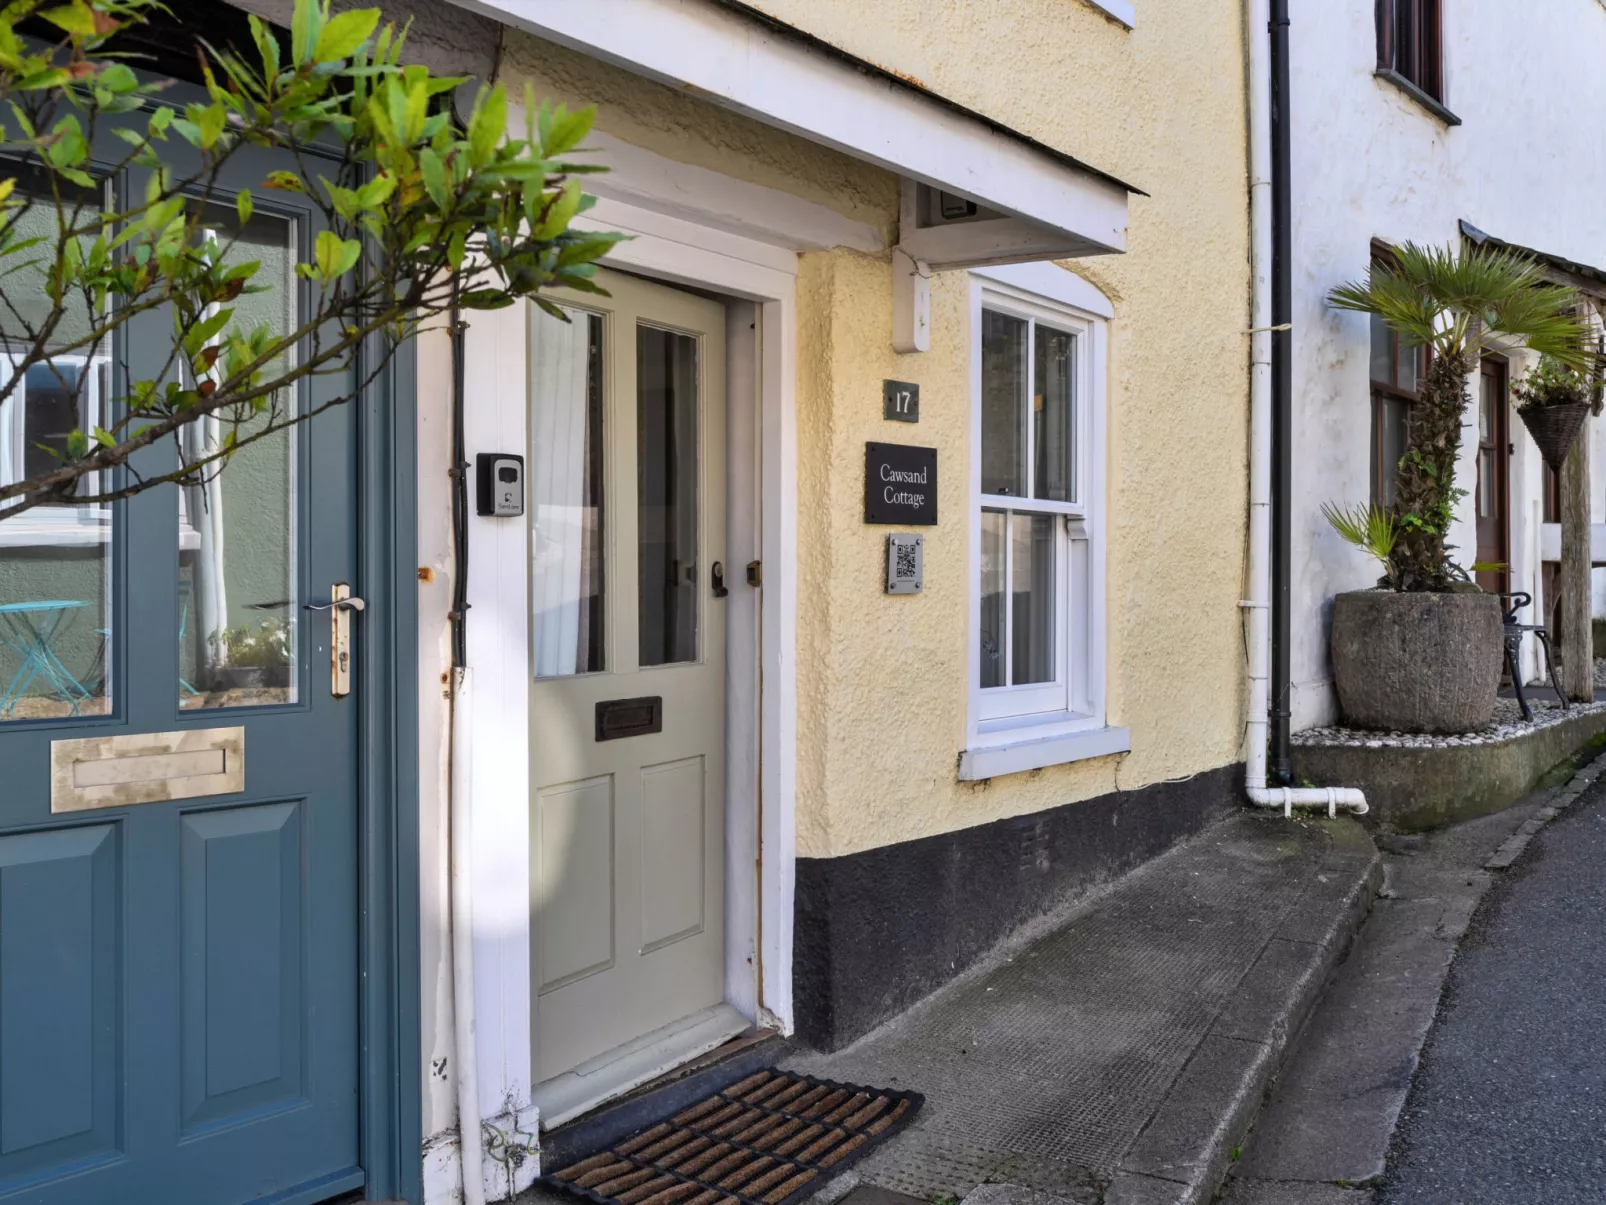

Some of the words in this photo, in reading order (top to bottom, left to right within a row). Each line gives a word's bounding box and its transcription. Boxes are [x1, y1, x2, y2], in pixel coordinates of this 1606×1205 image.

[896, 391, 910, 413] 17
[880, 463, 927, 484] Cawsand
[884, 485, 925, 509] Cottage
